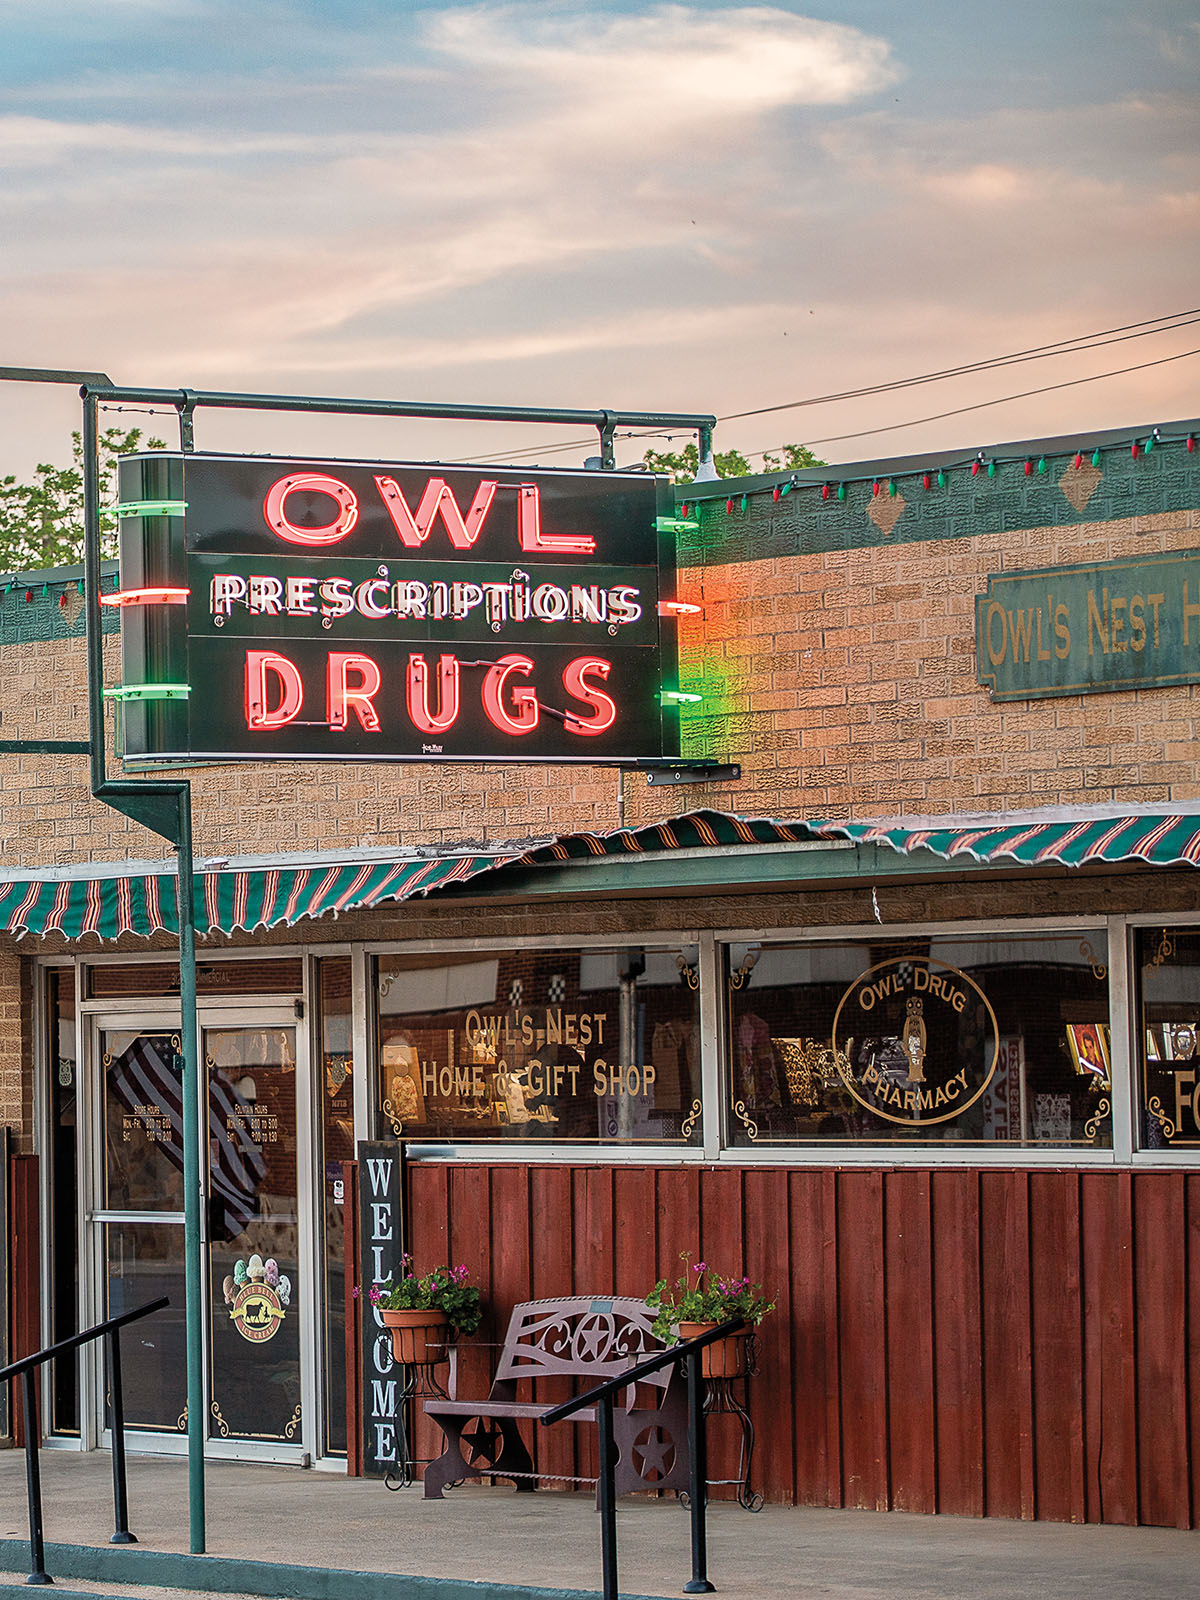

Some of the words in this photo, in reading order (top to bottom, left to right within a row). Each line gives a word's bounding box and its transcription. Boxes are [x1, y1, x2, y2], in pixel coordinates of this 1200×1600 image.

[263, 472, 597, 553] OWL
[210, 573, 642, 624] PRESCRIPTIONS
[986, 594, 1071, 666] OWL'S
[1087, 587, 1165, 656] NEST
[244, 650, 617, 736] DRUGS
[859, 974, 905, 1011] OWL
[914, 967, 967, 1013] DRUG
[465, 1009, 534, 1047] OWL'S
[546, 1008, 607, 1045] NEST
[422, 1061, 484, 1097] HOME
[497, 1059, 511, 1097] &
[527, 1060, 580, 1097] GIFT
[593, 1058, 656, 1097] SHOP
[861, 1068, 969, 1111] PHARMACY
[257, 1286, 274, 1299] BELL
[240, 1324, 252, 1336] ICE
[253, 1324, 275, 1339] CREAM
